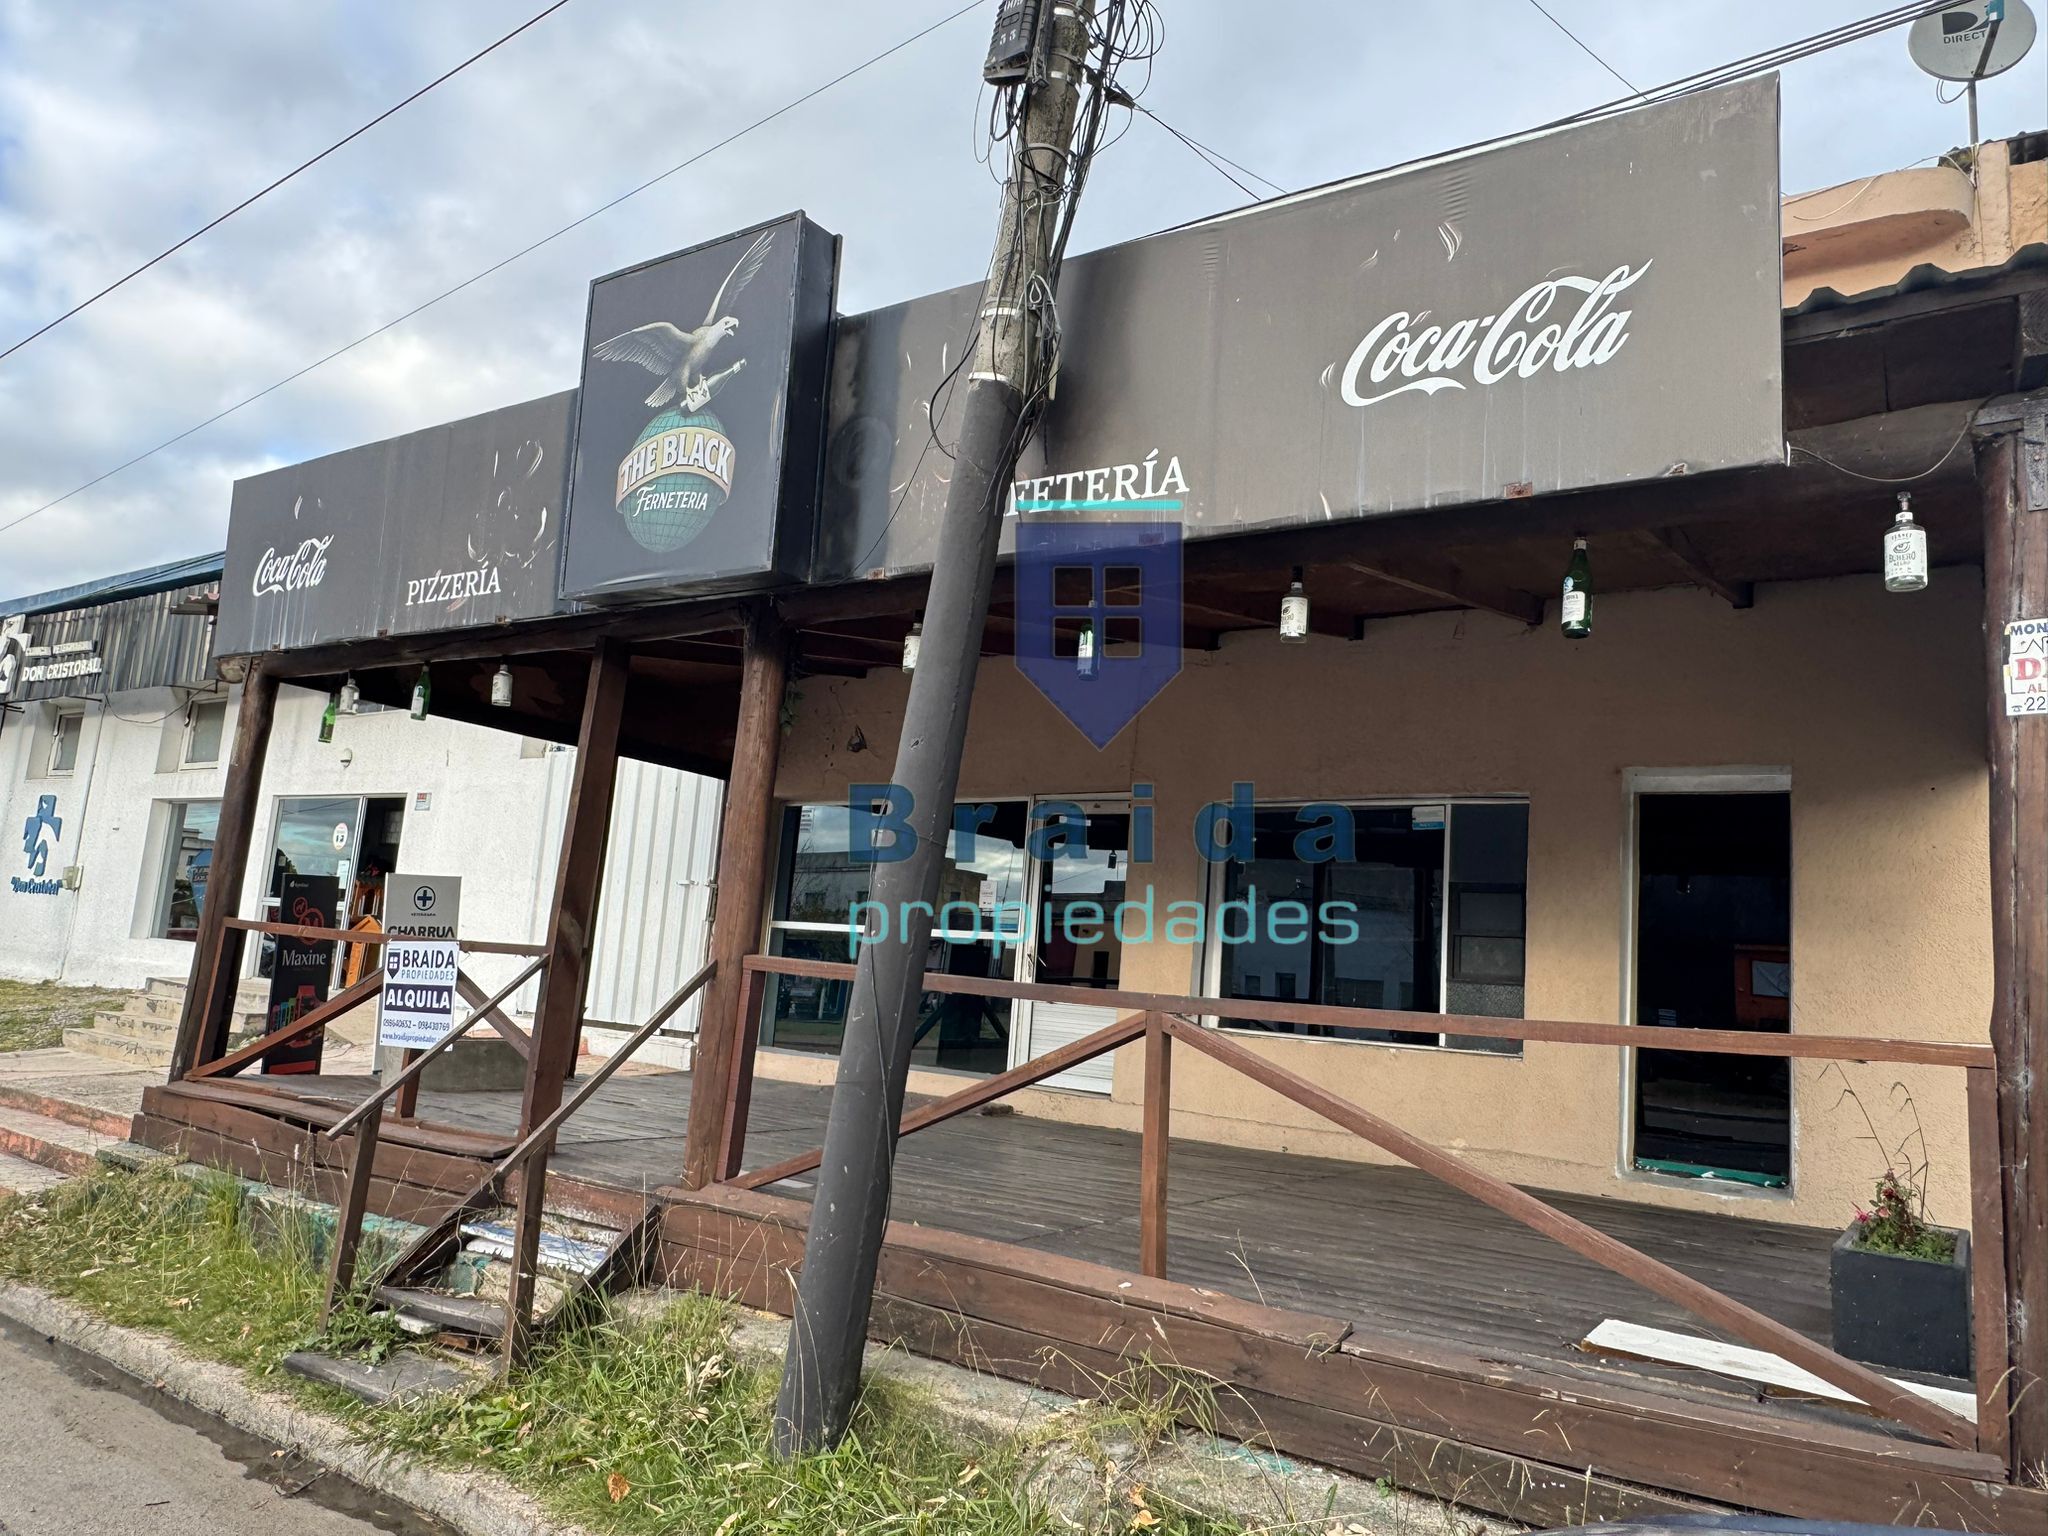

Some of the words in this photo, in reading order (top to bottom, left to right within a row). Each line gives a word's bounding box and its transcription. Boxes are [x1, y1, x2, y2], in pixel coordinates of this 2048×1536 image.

[1943, 31, 1986, 44] DIRECT
[1341, 258, 1654, 408] Coca-Cola
[621, 440, 659, 495] THE
[661, 432, 732, 486] BLACK
[1004, 448, 1190, 518] FETERÍA
[252, 534, 335, 598] Coca-Cola
[405, 561, 502, 607] PIZZERÍA
[22, 666, 47, 682] DON
[46, 657, 102, 679] CRISTOBAL
[387, 925, 455, 938] CHARRUA
[282, 949, 327, 967] Maxine
[402, 950, 456, 969] BRAIDA
[401, 969, 455, 981] PROPIEDADES
[386, 988, 450, 1009] ALQUILA
